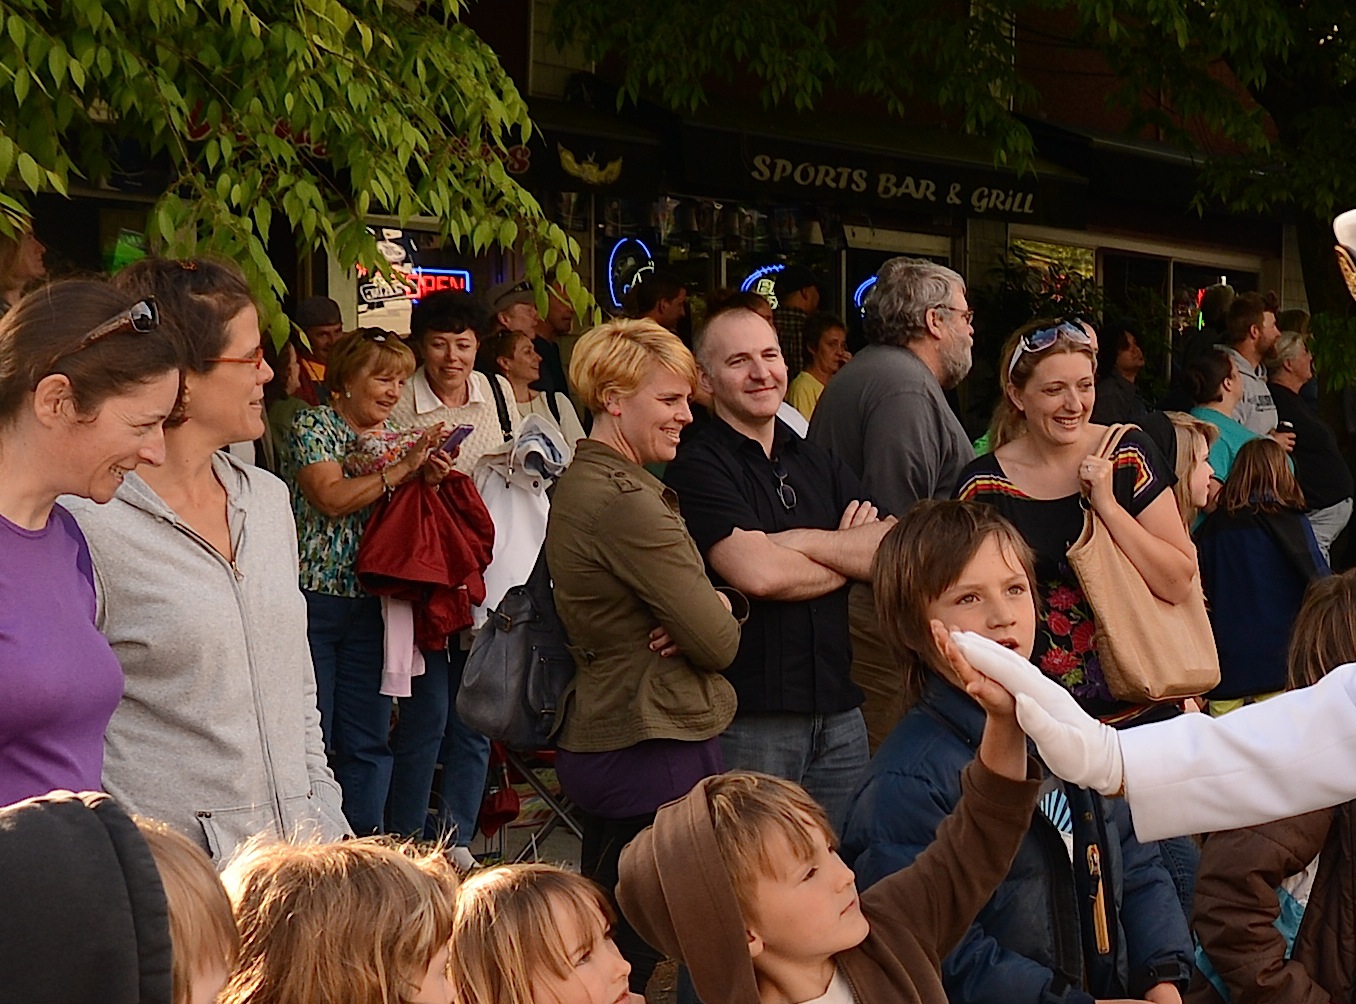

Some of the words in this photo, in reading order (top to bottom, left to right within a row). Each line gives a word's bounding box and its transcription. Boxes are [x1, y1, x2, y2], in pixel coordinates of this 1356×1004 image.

[751, 154, 868, 192] SPORTS
[877, 173, 937, 201] BAR
[946, 182, 962, 205] &
[405, 273, 466, 299] OPEN
